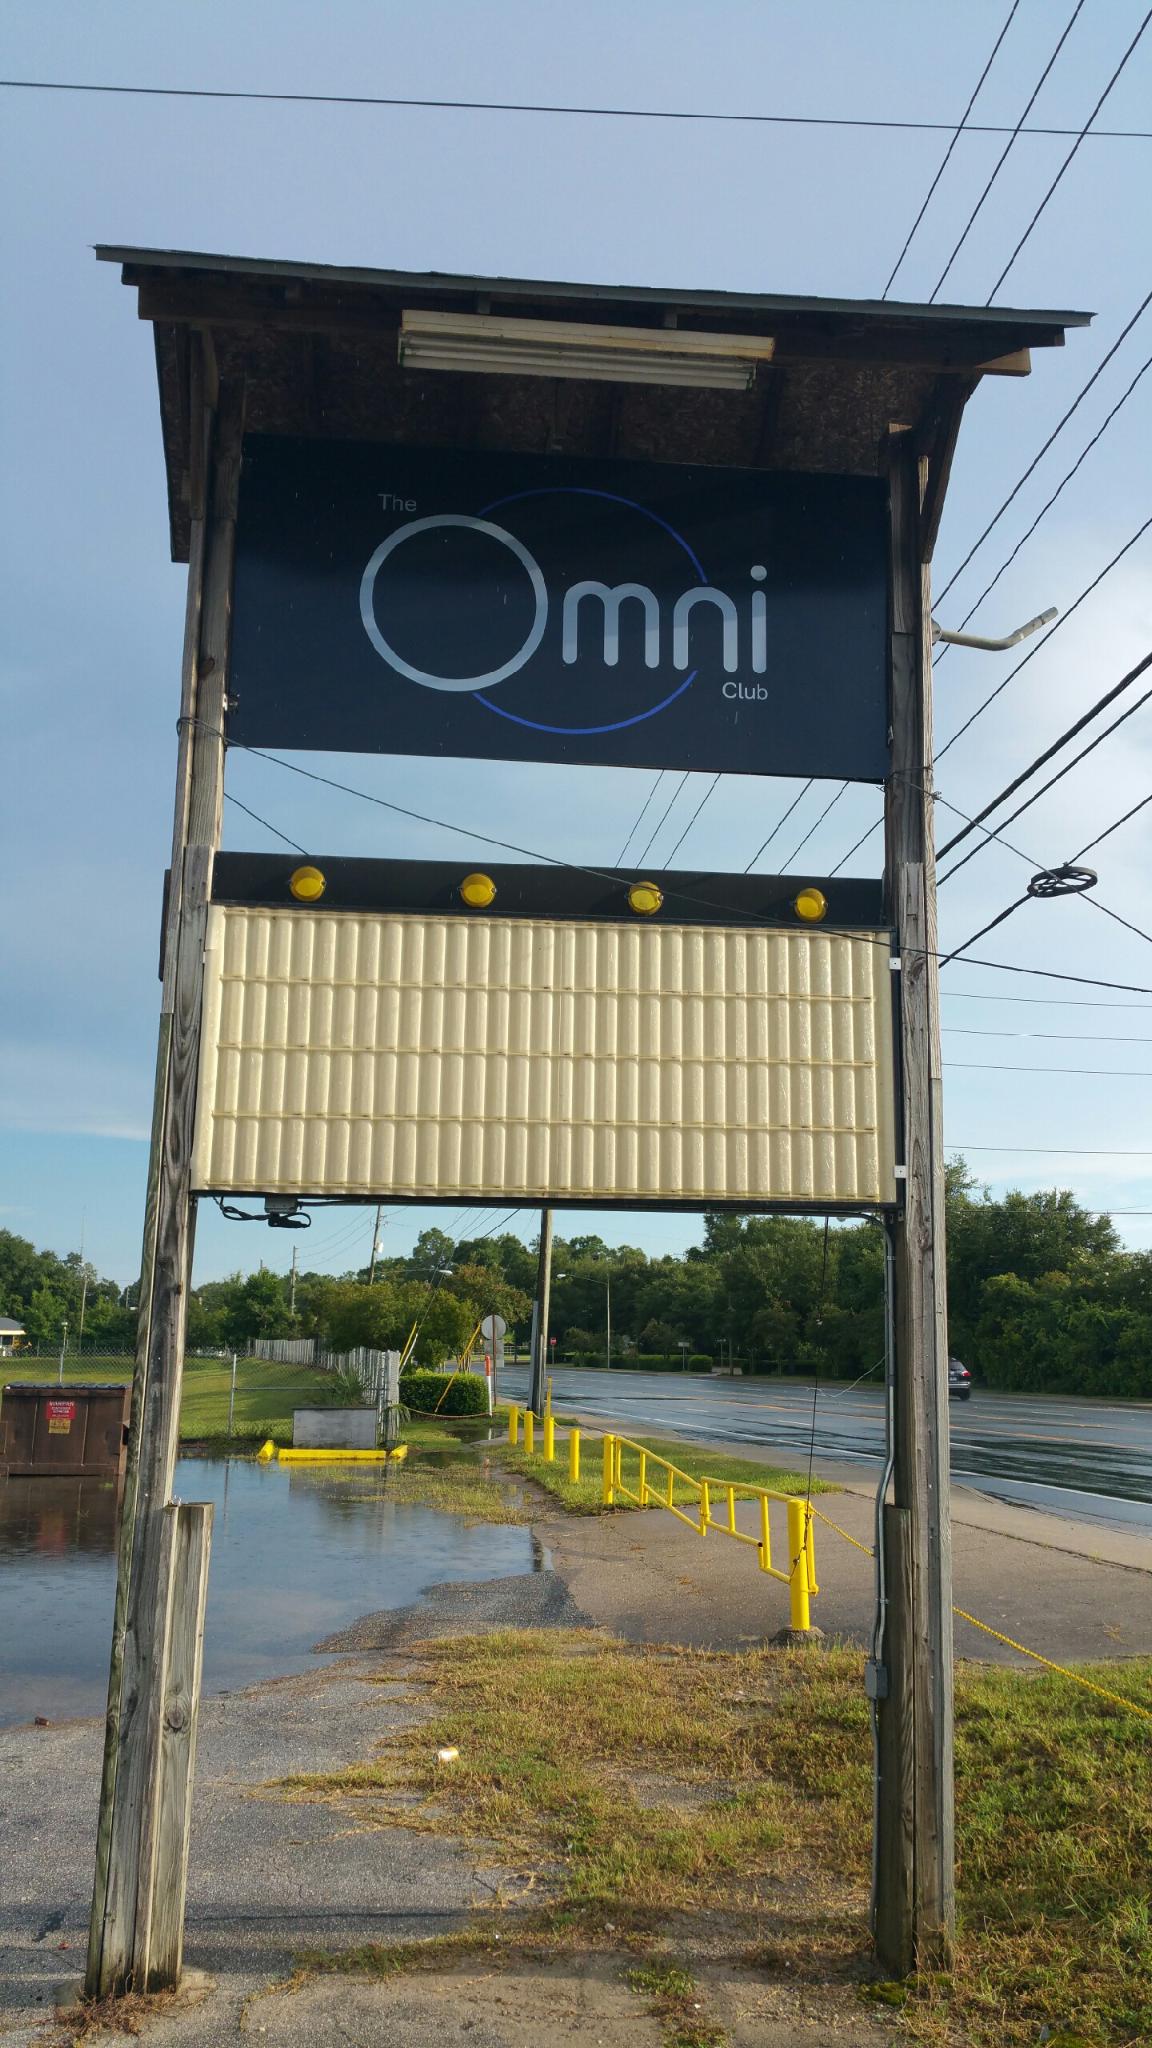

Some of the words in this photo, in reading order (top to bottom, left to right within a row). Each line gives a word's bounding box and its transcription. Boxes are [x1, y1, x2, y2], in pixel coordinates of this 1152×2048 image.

[377, 493, 417, 512] The
[359, 513, 768, 692] Omni
[722, 681, 769, 700] Club
